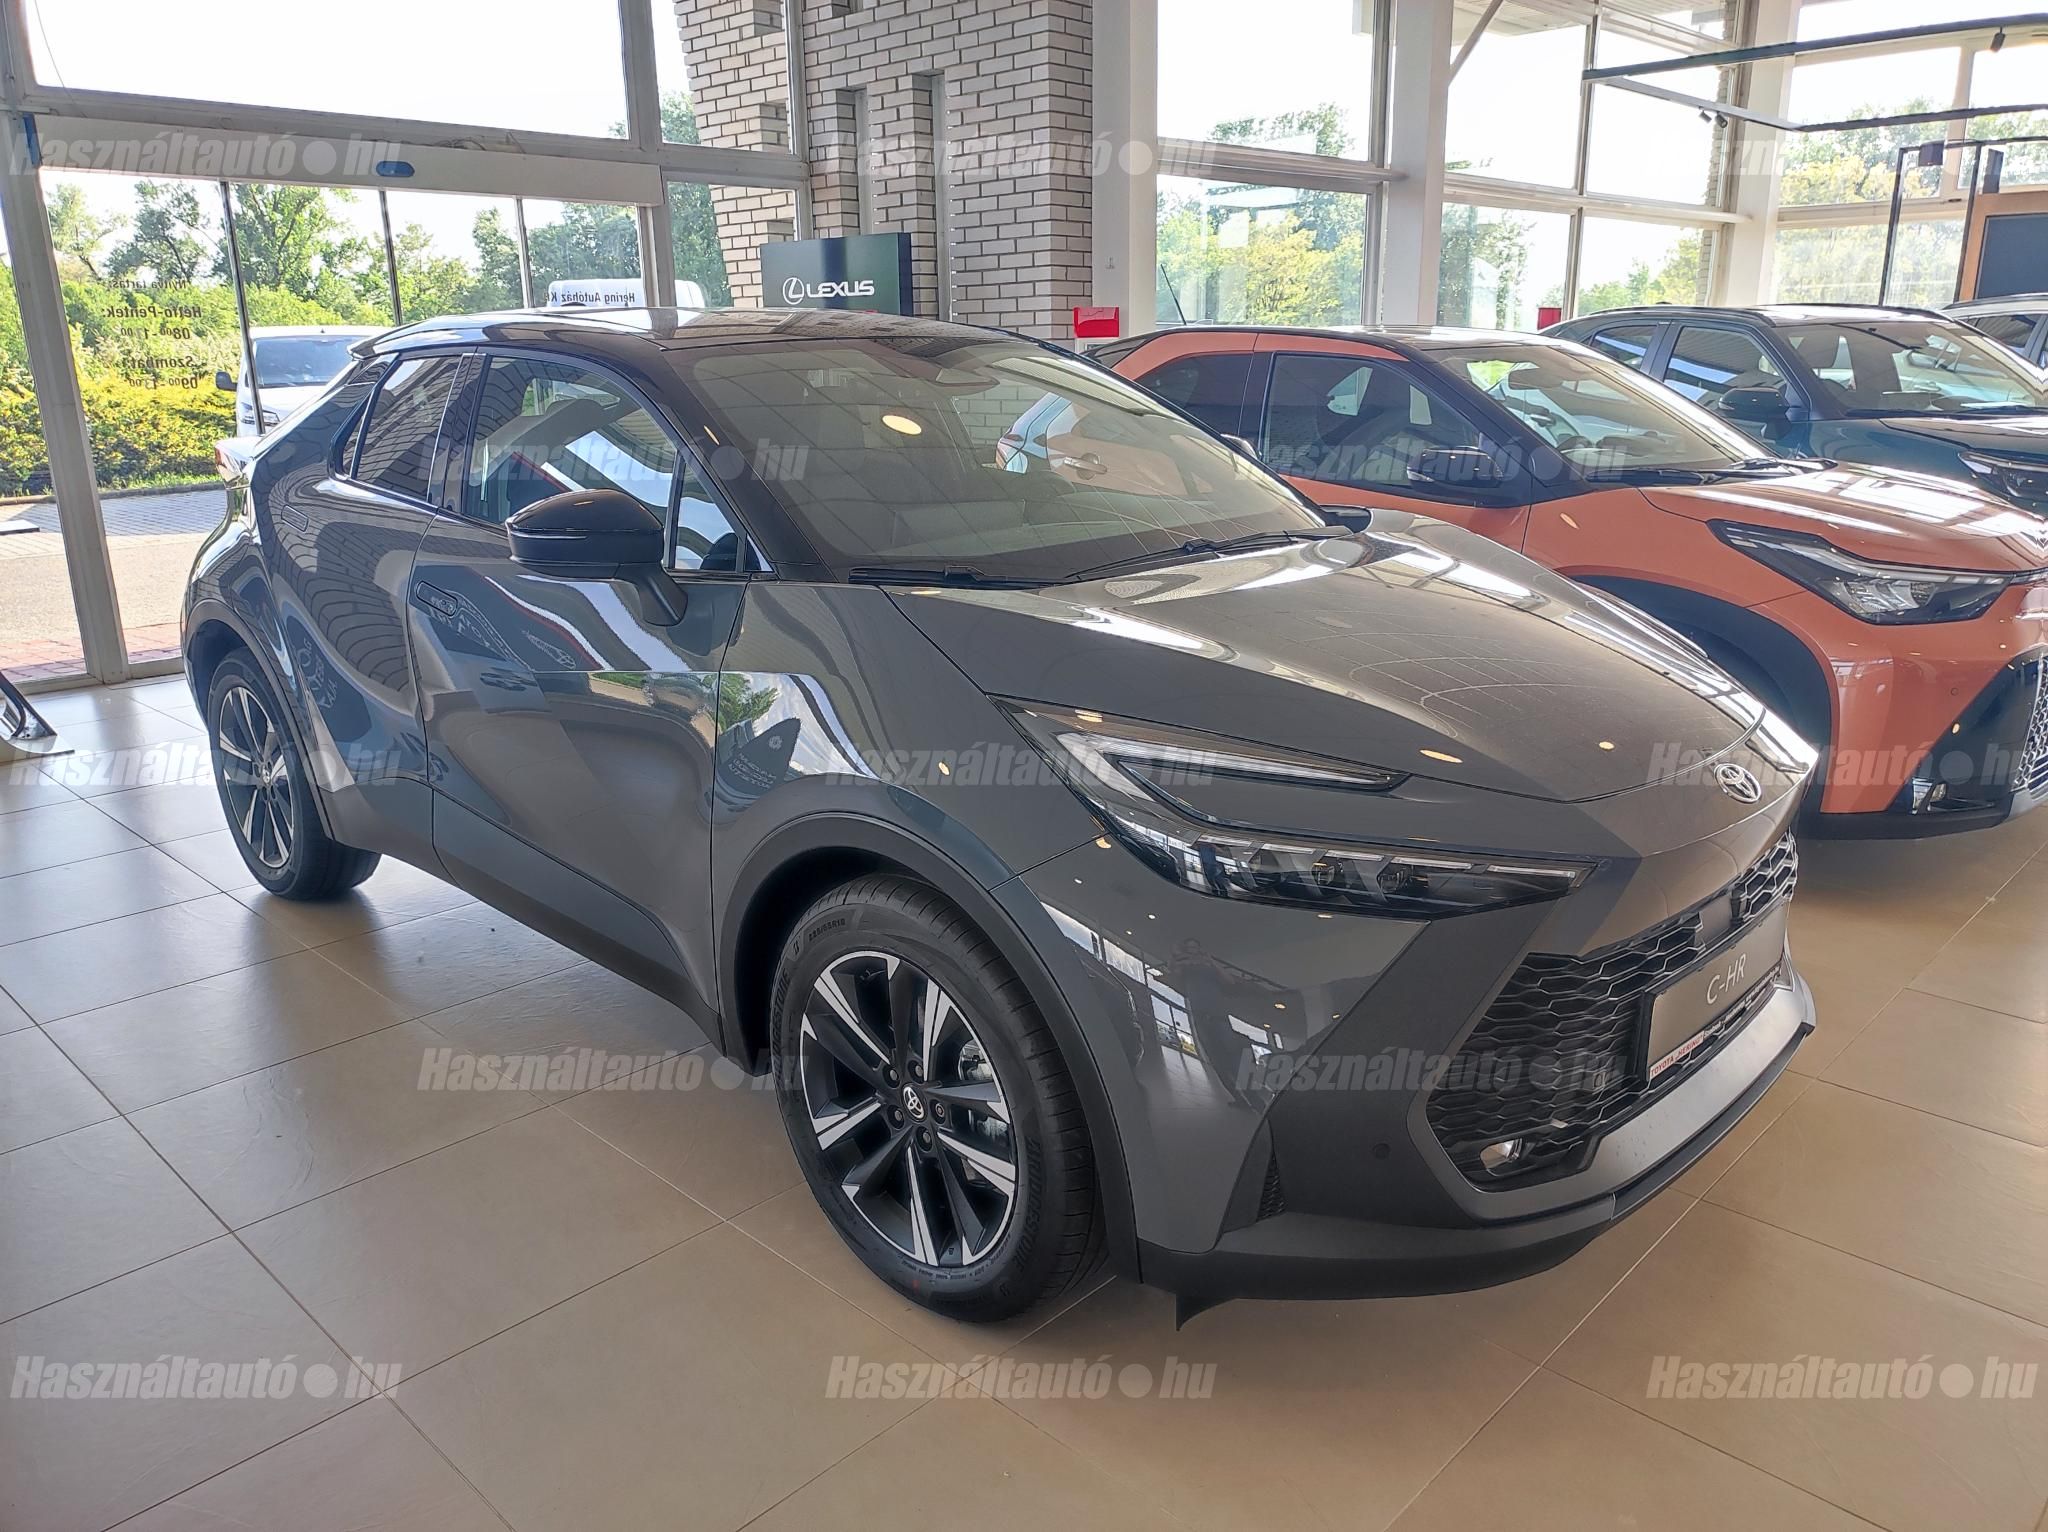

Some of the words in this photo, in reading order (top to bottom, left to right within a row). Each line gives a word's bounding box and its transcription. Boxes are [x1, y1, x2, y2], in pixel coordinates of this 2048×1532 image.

[806, 280, 875, 298] LEXUS
[1706, 953, 1746, 1005] C-HR
[1650, 1056, 1674, 1077] TOYOTA
